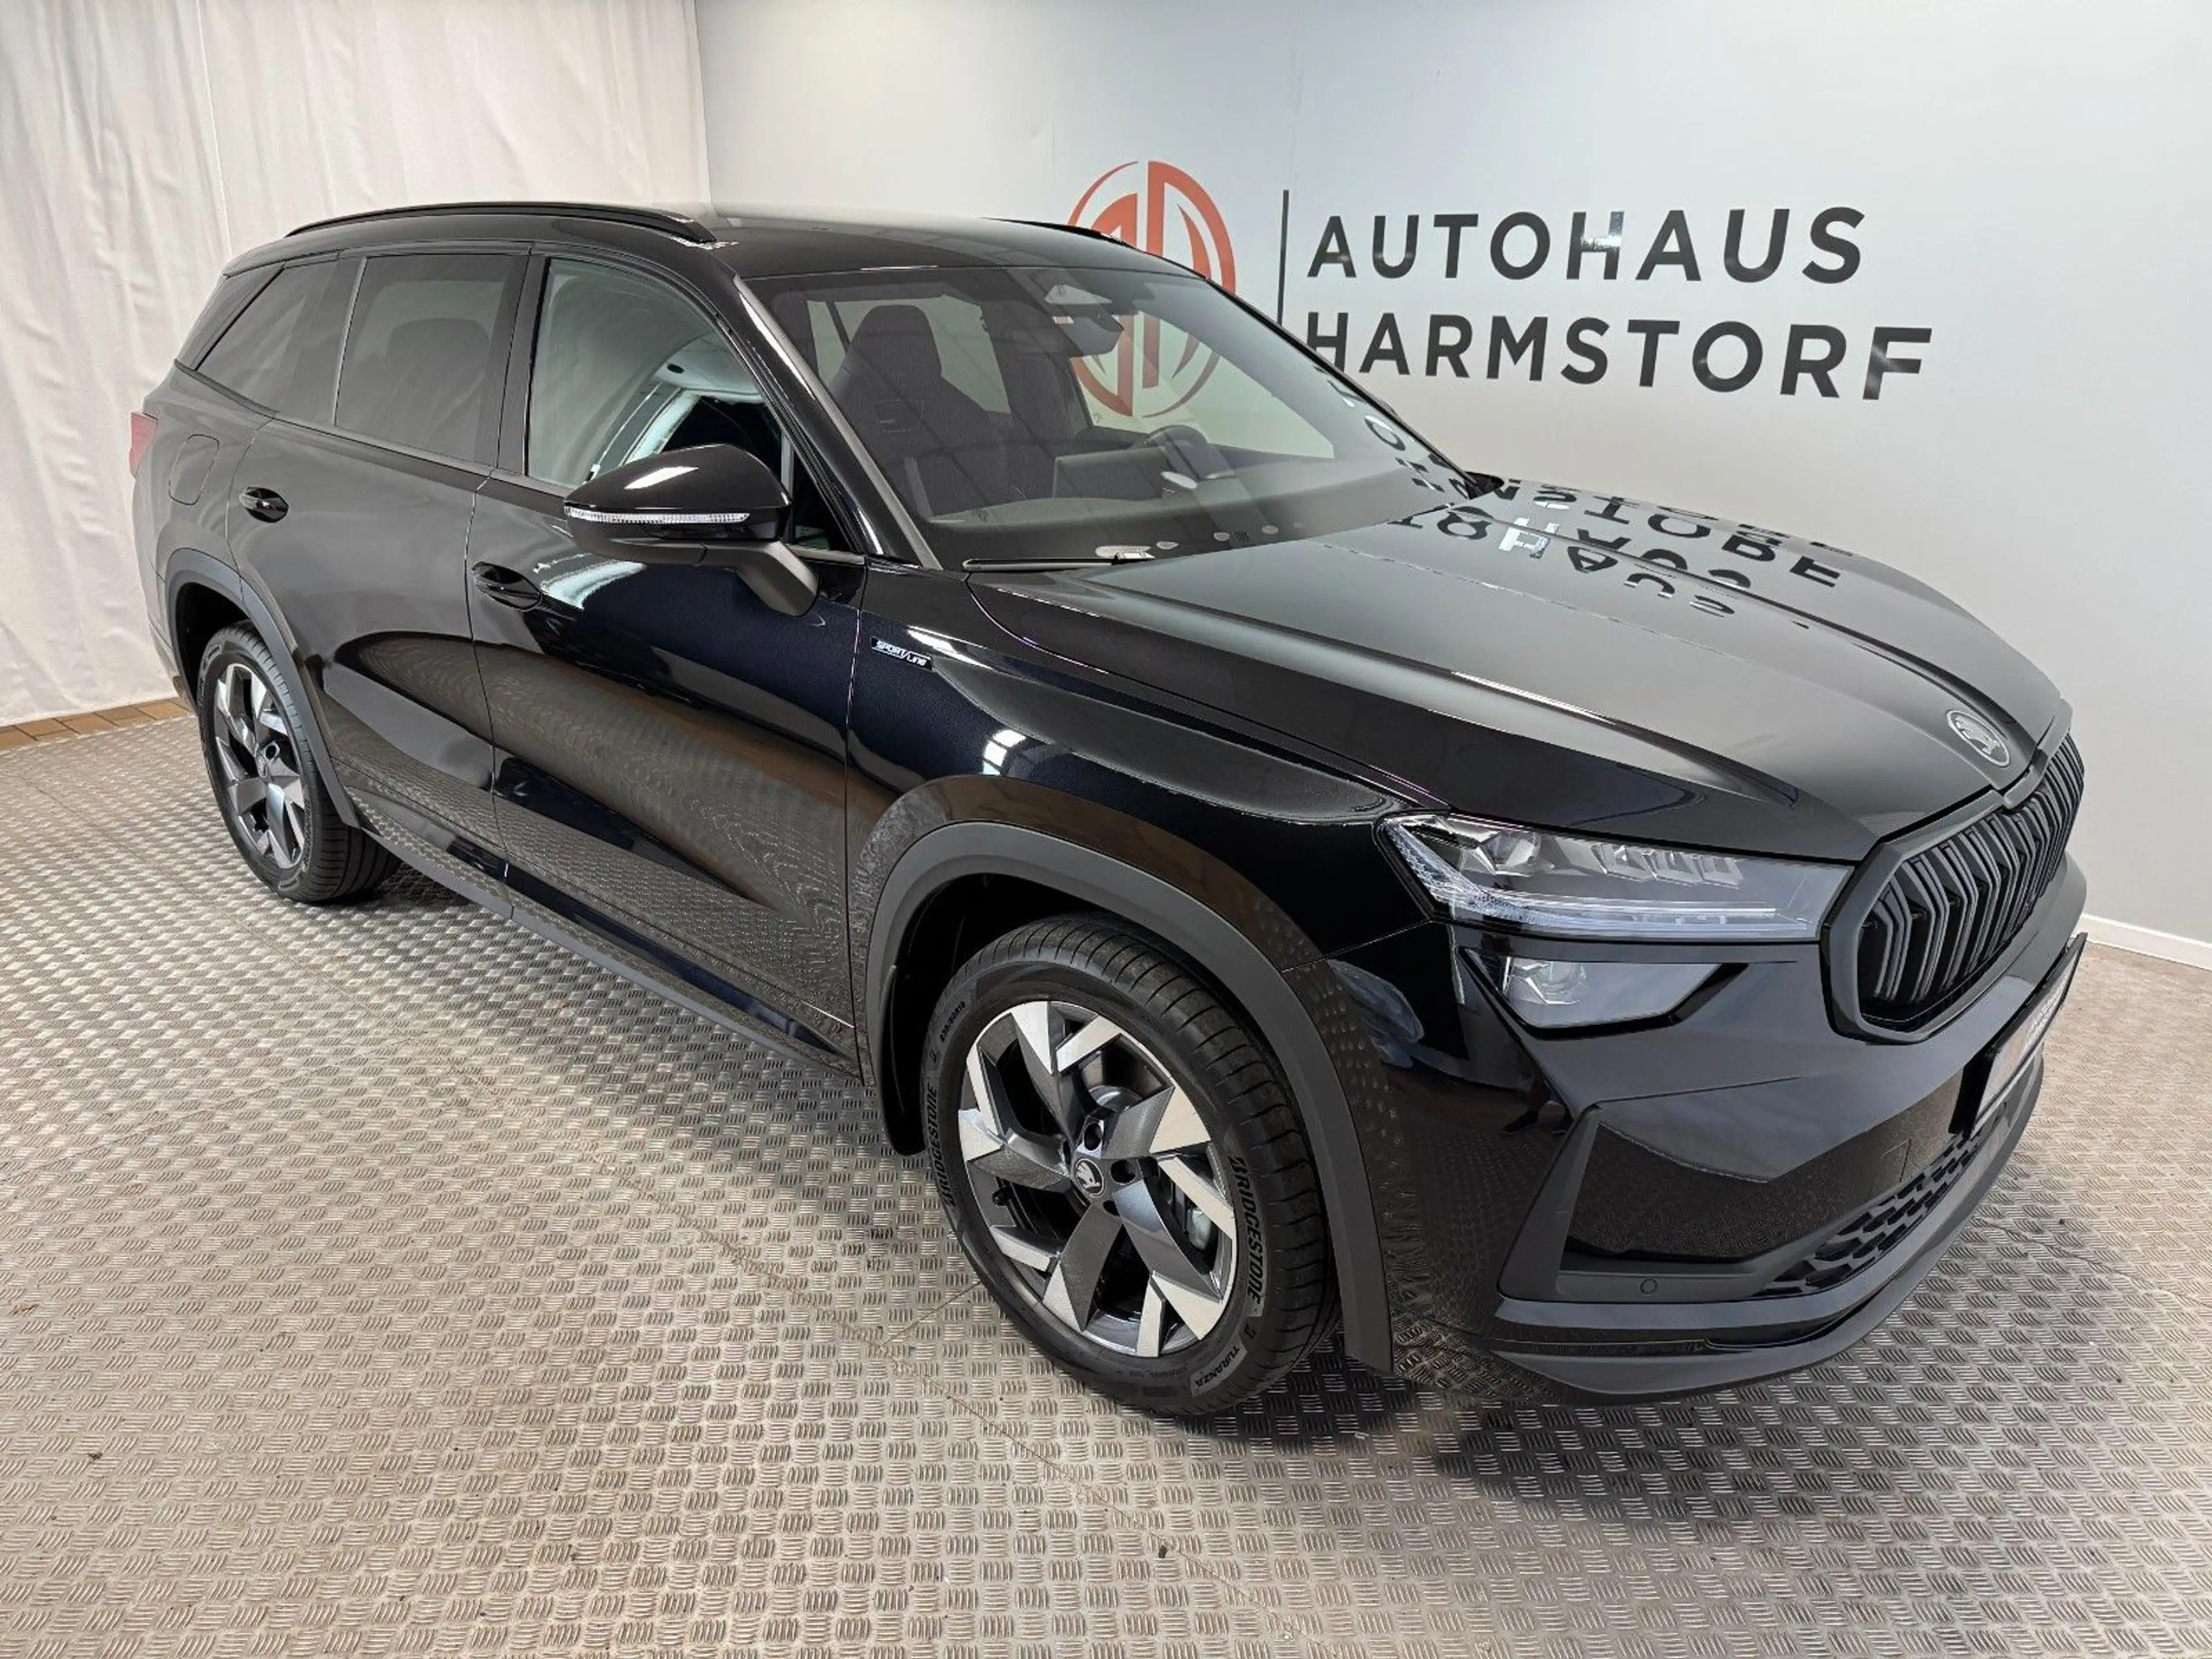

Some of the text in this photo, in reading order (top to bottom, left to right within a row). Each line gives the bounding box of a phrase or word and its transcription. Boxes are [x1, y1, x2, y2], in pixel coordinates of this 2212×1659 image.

[1307, 207, 1865, 284] AUTOHAUS
[1306, 311, 1932, 400] HARMSTORF
[926, 1082, 956, 1208] BRIDGESTONE
[1228, 1154, 1264, 1305] BRIDGESTONE
[1194, 1346, 1240, 1388] TURANZA
